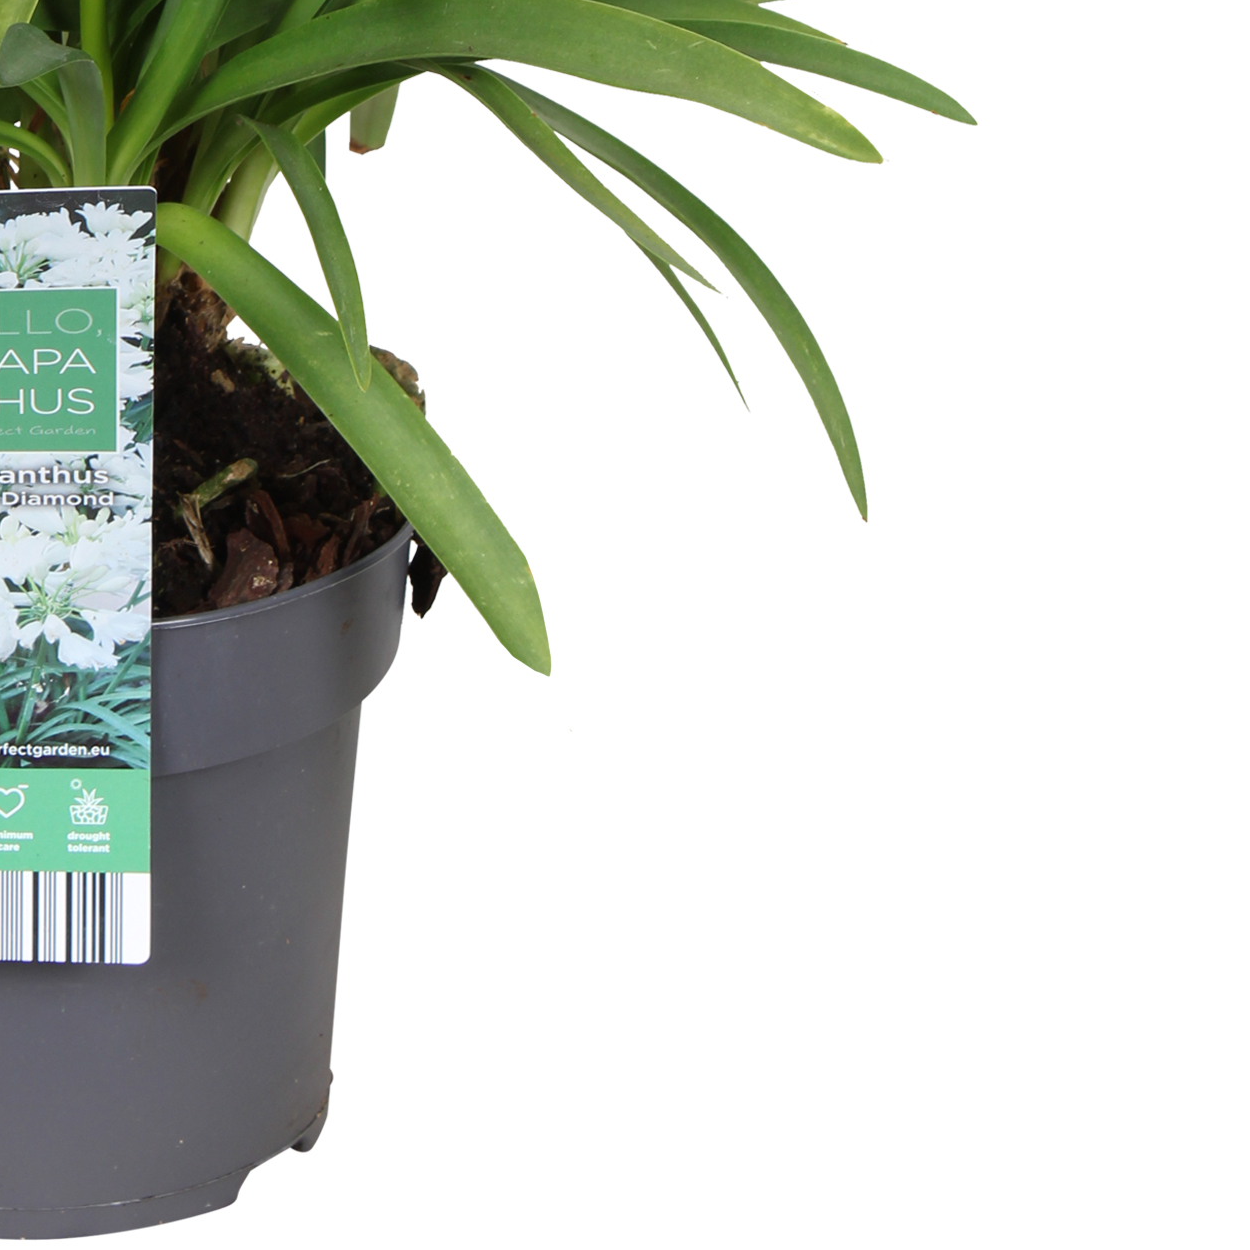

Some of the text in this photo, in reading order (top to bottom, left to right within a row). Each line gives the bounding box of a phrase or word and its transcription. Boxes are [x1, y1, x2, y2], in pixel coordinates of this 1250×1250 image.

[29, 425, 97, 436] Garden
[2, 491, 114, 507] Diamond
[67, 830, 111, 843] drought
[67, 843, 110, 853] tolerant
